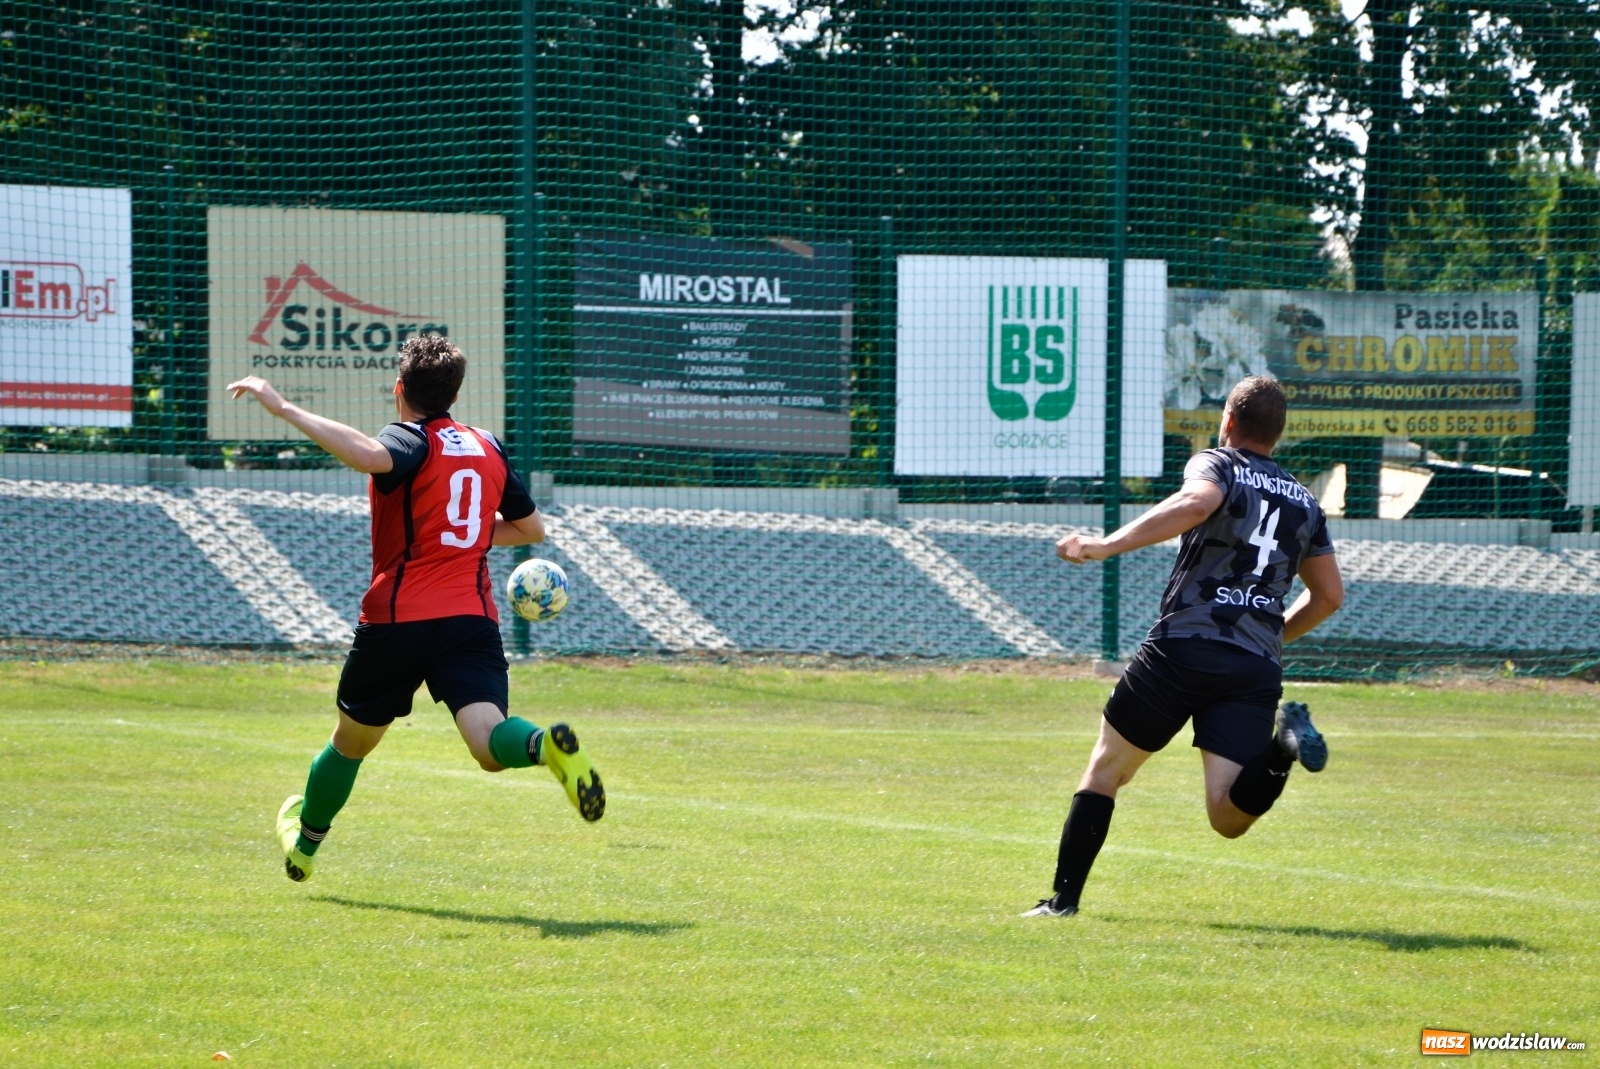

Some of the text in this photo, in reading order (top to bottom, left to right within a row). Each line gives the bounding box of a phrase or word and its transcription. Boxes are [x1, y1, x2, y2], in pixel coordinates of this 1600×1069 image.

[639, 274, 792, 304] MIROSTAL
[689, 322, 748, 332] BALUSTRADY
[1394, 302, 1520, 330] Pasieka
[699, 336, 738, 347] SCHODY
[353, 356, 402, 369] DACH
[1001, 324, 1065, 385] BS
[1295, 335, 1520, 374] CHROMIK
[1363, 385, 1444, 400] PRODUKTY
[1447, 385, 1516, 400] PSZCZELE
[1180, 415, 1518, 433] Gorzy aciborska 34 668 582 016
[994, 433, 1069, 449] GORZYCE
[440, 468, 482, 548] 9
[1249, 499, 1280, 577] 4
